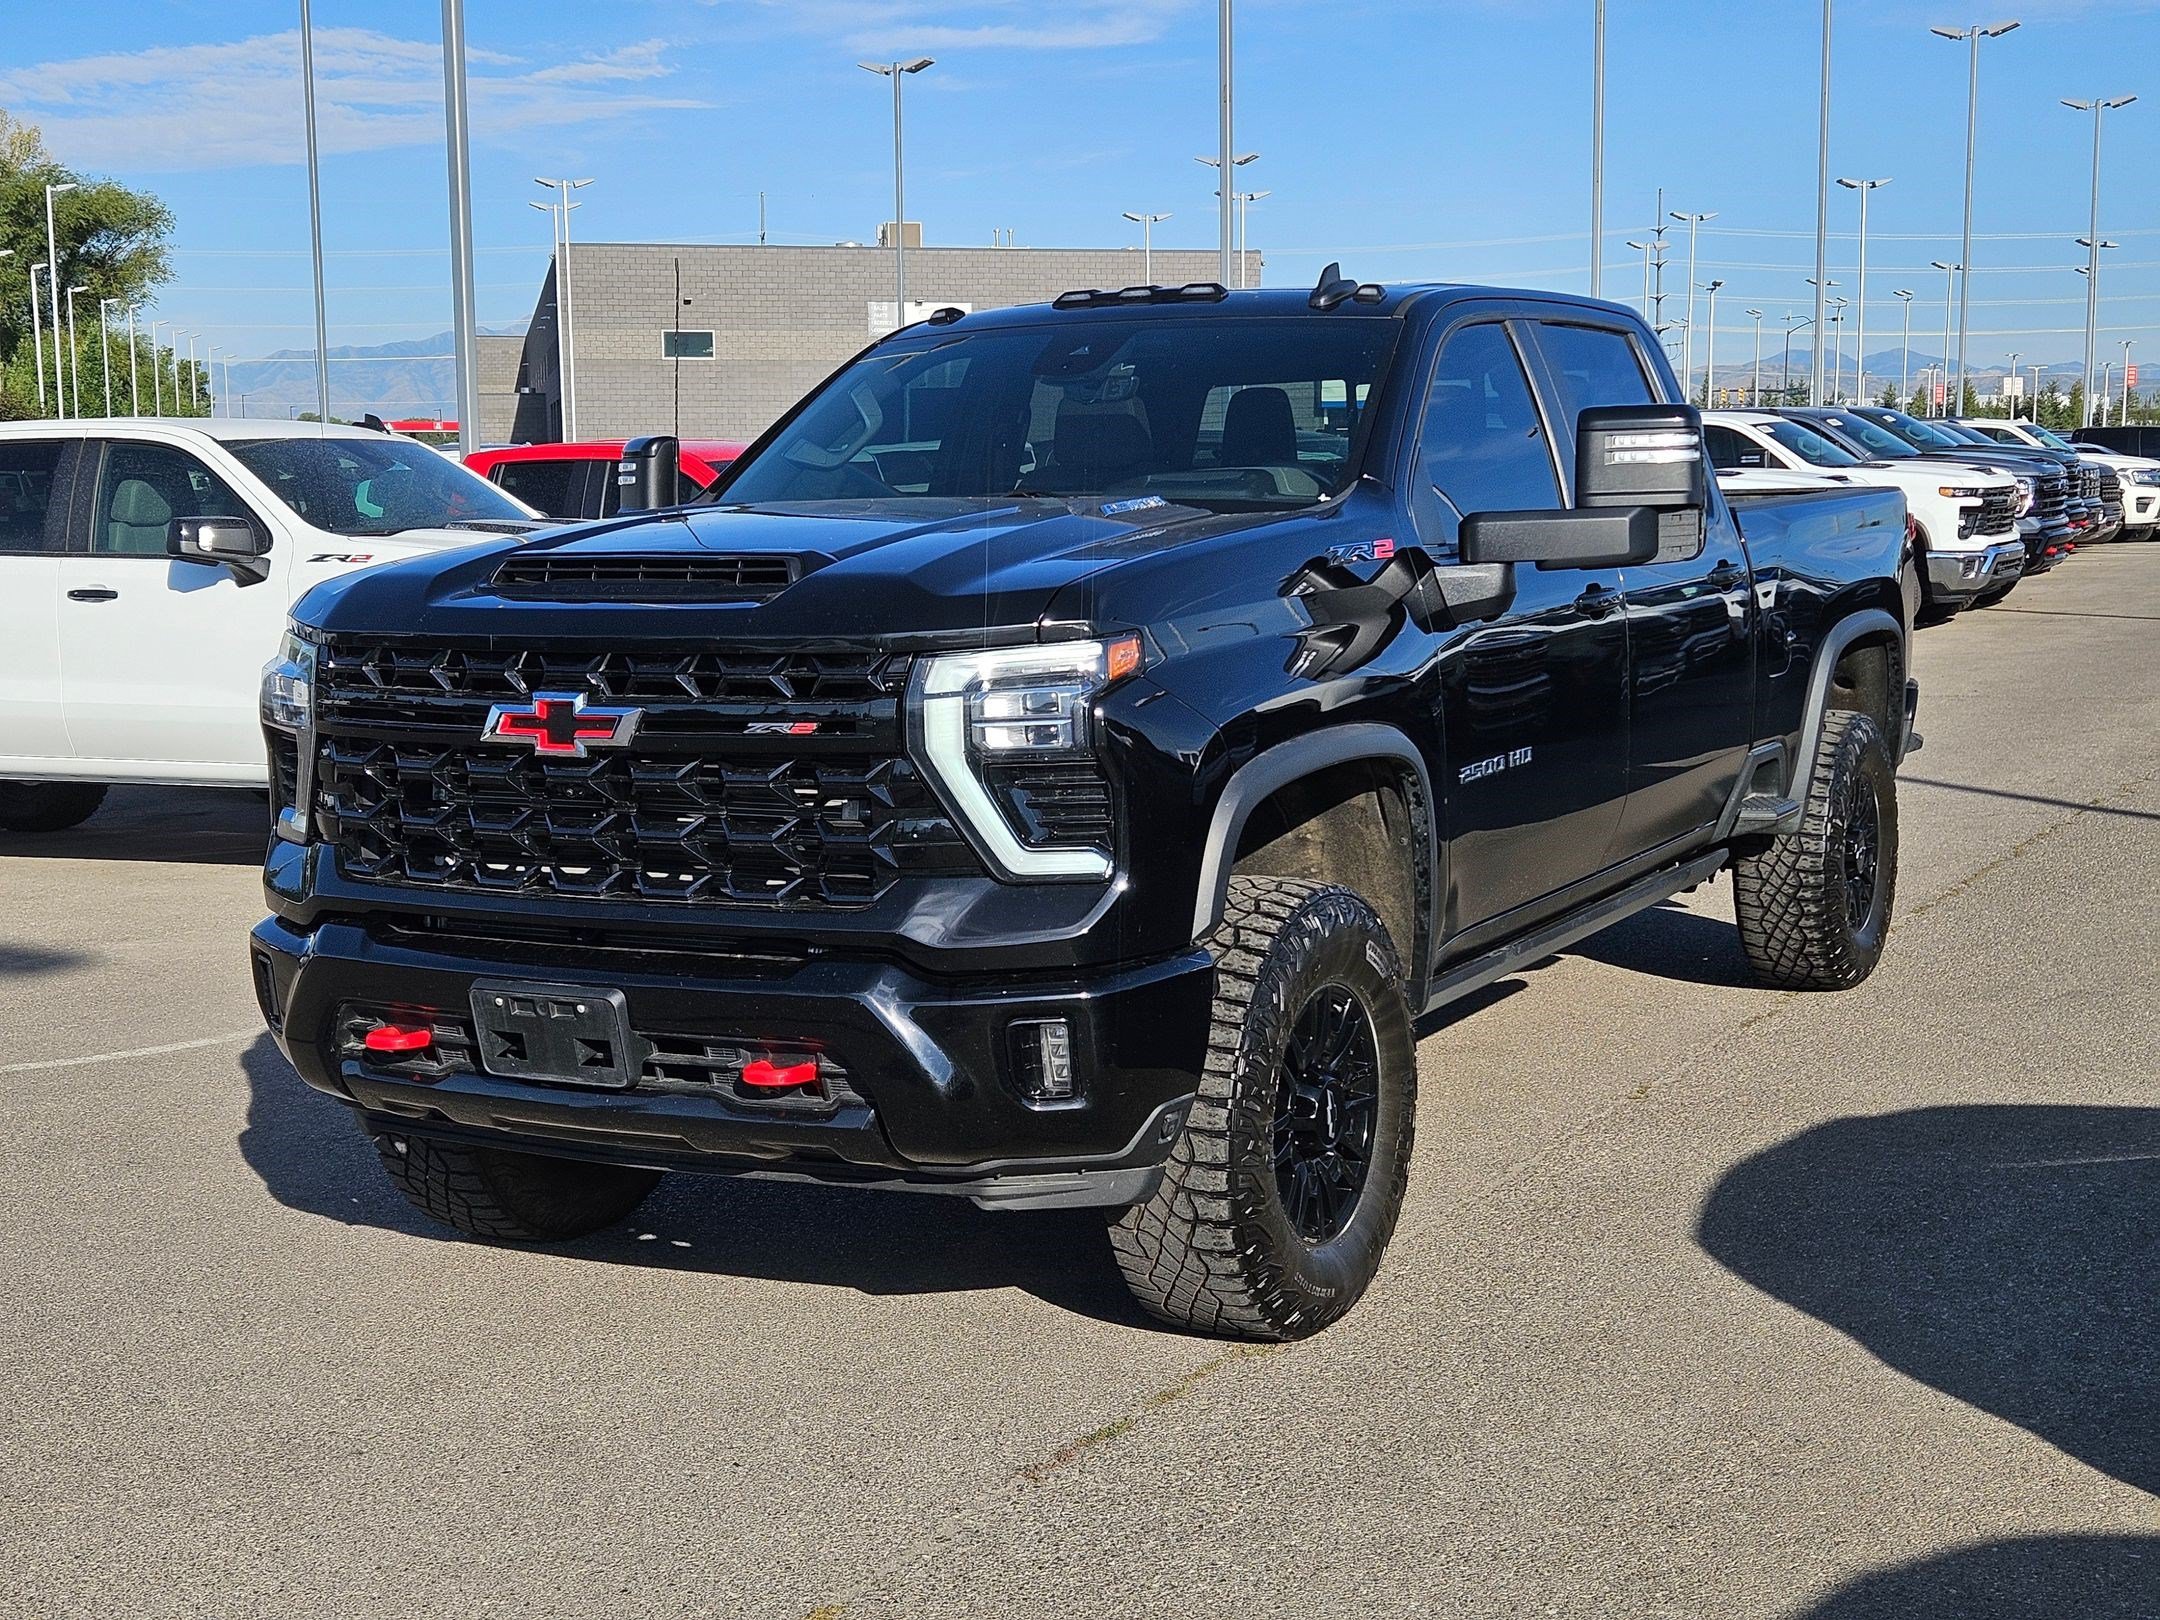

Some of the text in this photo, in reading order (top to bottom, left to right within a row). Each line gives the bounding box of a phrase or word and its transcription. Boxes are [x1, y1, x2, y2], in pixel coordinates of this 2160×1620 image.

[306, 553, 375, 563] ZR2
[1324, 539, 1395, 567] ZR2
[742, 722, 821, 735] ZR2
[1458, 746, 1533, 785] 2500 HD
